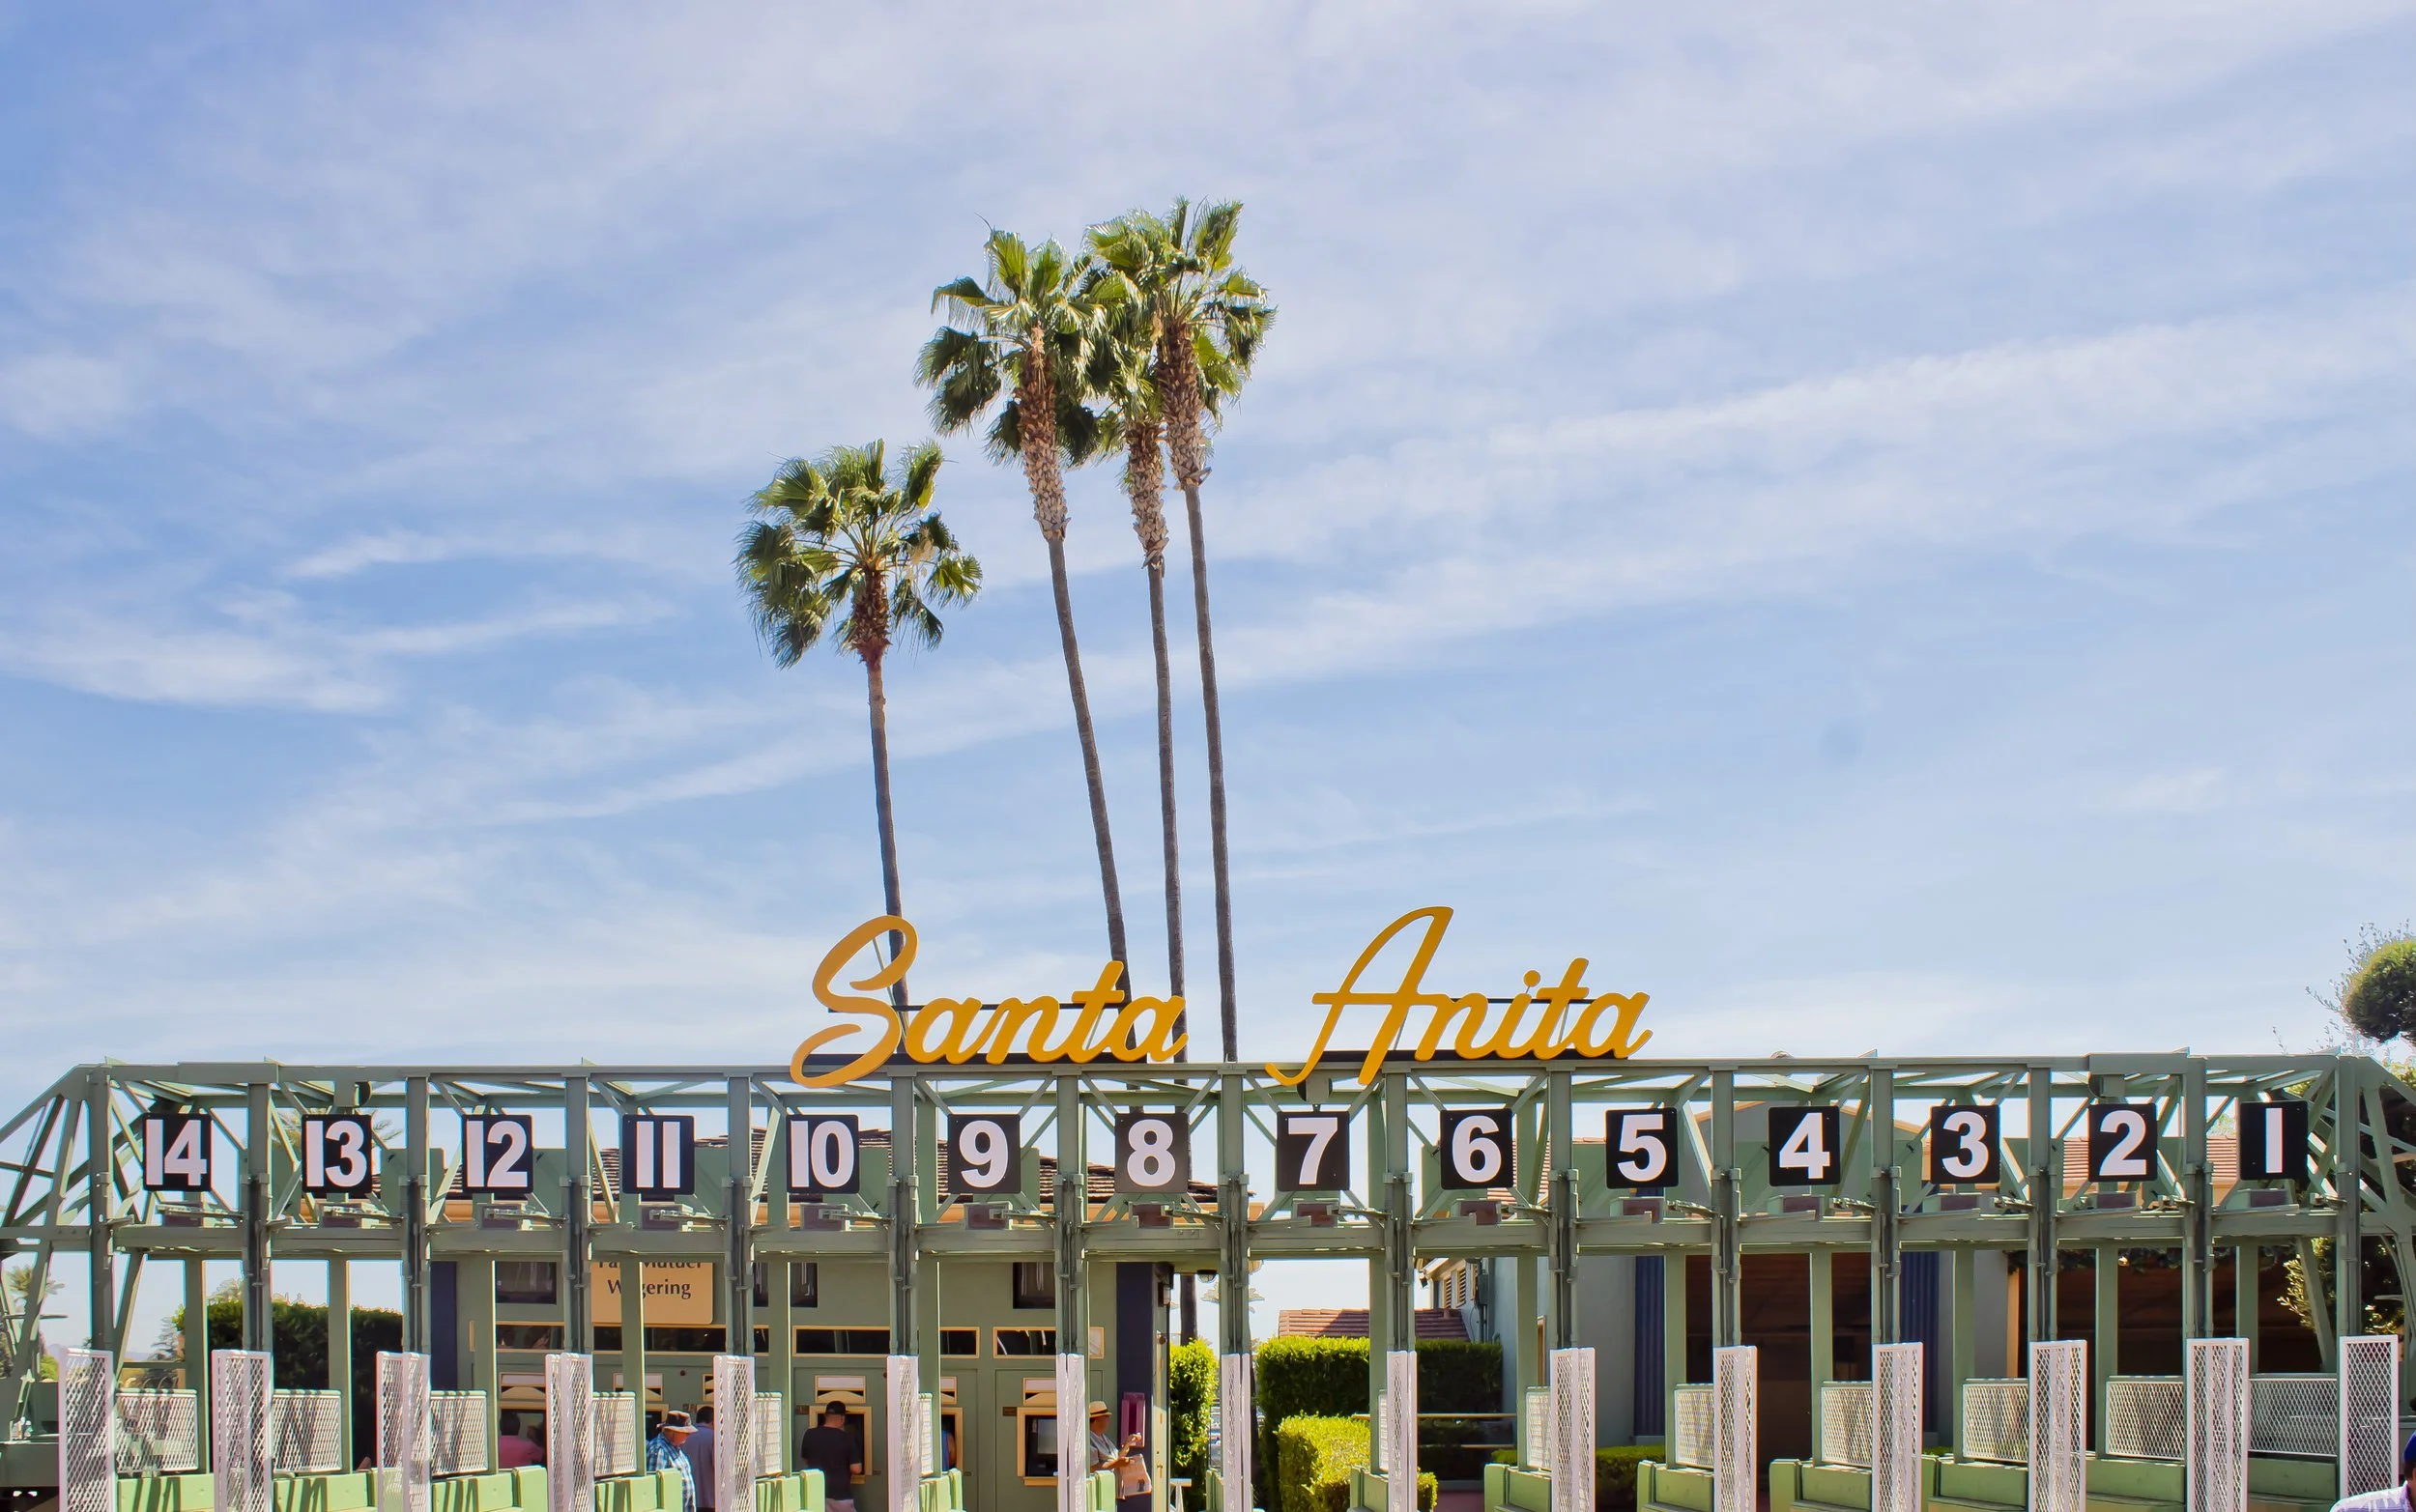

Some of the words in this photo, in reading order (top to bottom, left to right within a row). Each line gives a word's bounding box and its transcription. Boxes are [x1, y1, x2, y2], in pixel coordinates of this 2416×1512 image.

[790, 915, 1188, 1088] Santa
[1263, 906, 1652, 1088] Anita
[146, 1119, 208, 1186] 14
[305, 1120, 367, 1187] 13
[466, 1120, 529, 1187] 12
[636, 1121, 680, 1188] 11
[790, 1120, 854, 1188] 10
[959, 1120, 1009, 1188] 9
[1126, 1119, 1176, 1187] 8
[1287, 1117, 1338, 1185] 7
[1452, 1115, 1502, 1183] 6
[1617, 1113, 1667, 1182] 5
[1779, 1112, 1830, 1180] 4
[1941, 1111, 1989, 1178] 3
[2098, 1109, 2147, 1177] 2
[2265, 1107, 2283, 1174] 1
[607, 1278, 692, 1300] Wering
